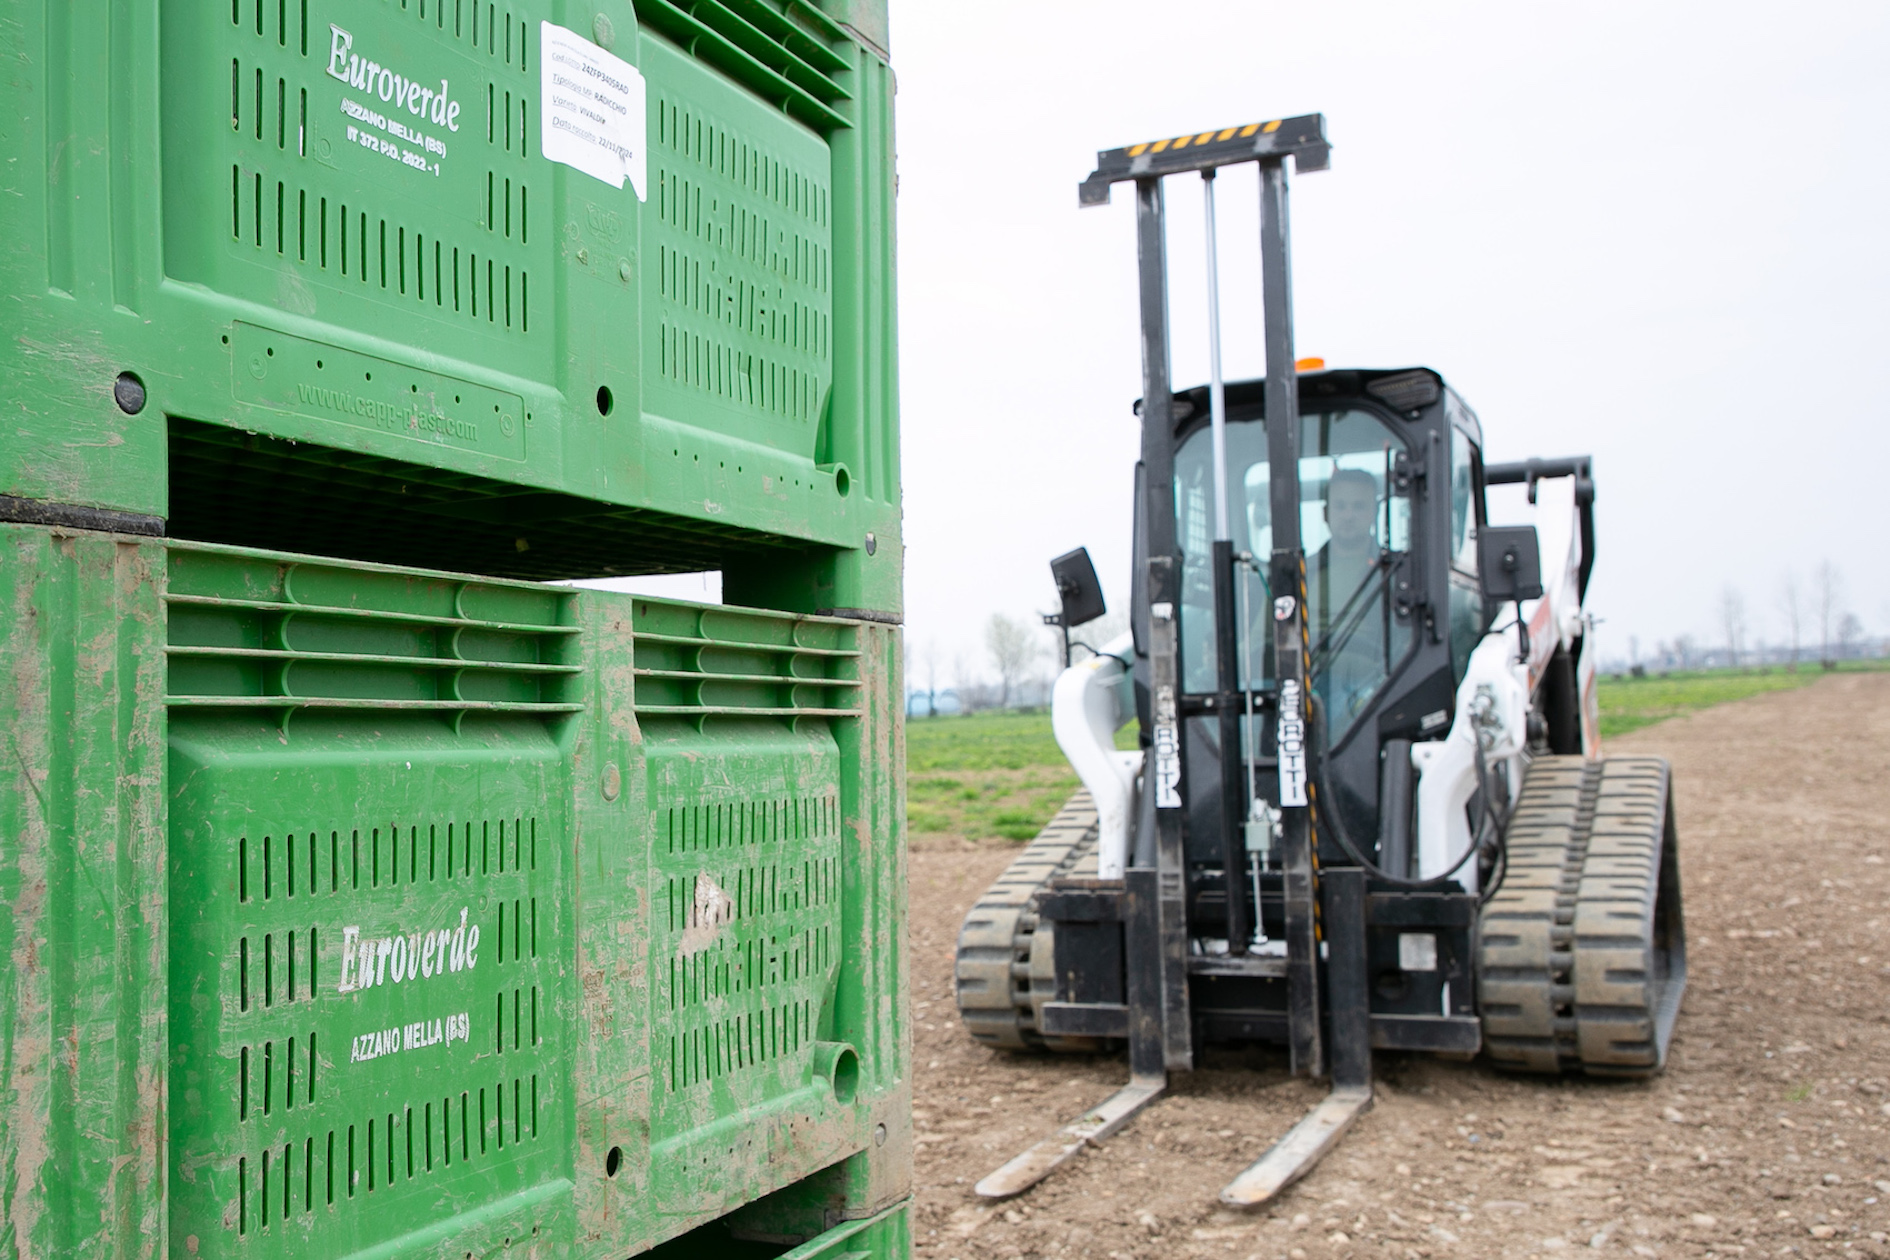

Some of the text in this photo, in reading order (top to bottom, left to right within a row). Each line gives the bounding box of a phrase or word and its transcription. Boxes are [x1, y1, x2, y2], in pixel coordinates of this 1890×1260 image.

[325, 23, 461, 132] Euroverde
[594, 92, 628, 115] RADICCHIO
[340, 97, 447, 159] AZZANO MELLA (BS)
[346, 125, 359, 143] IT
[360, 131, 380, 152] 372
[401, 149, 427, 172] 2022
[433, 162, 440, 177] 1
[298, 383, 478, 441] www.capp-plast.com
[337, 905, 480, 994] Euroverde
[350, 1011, 471, 1064] AZZANO MELLA (BS)
